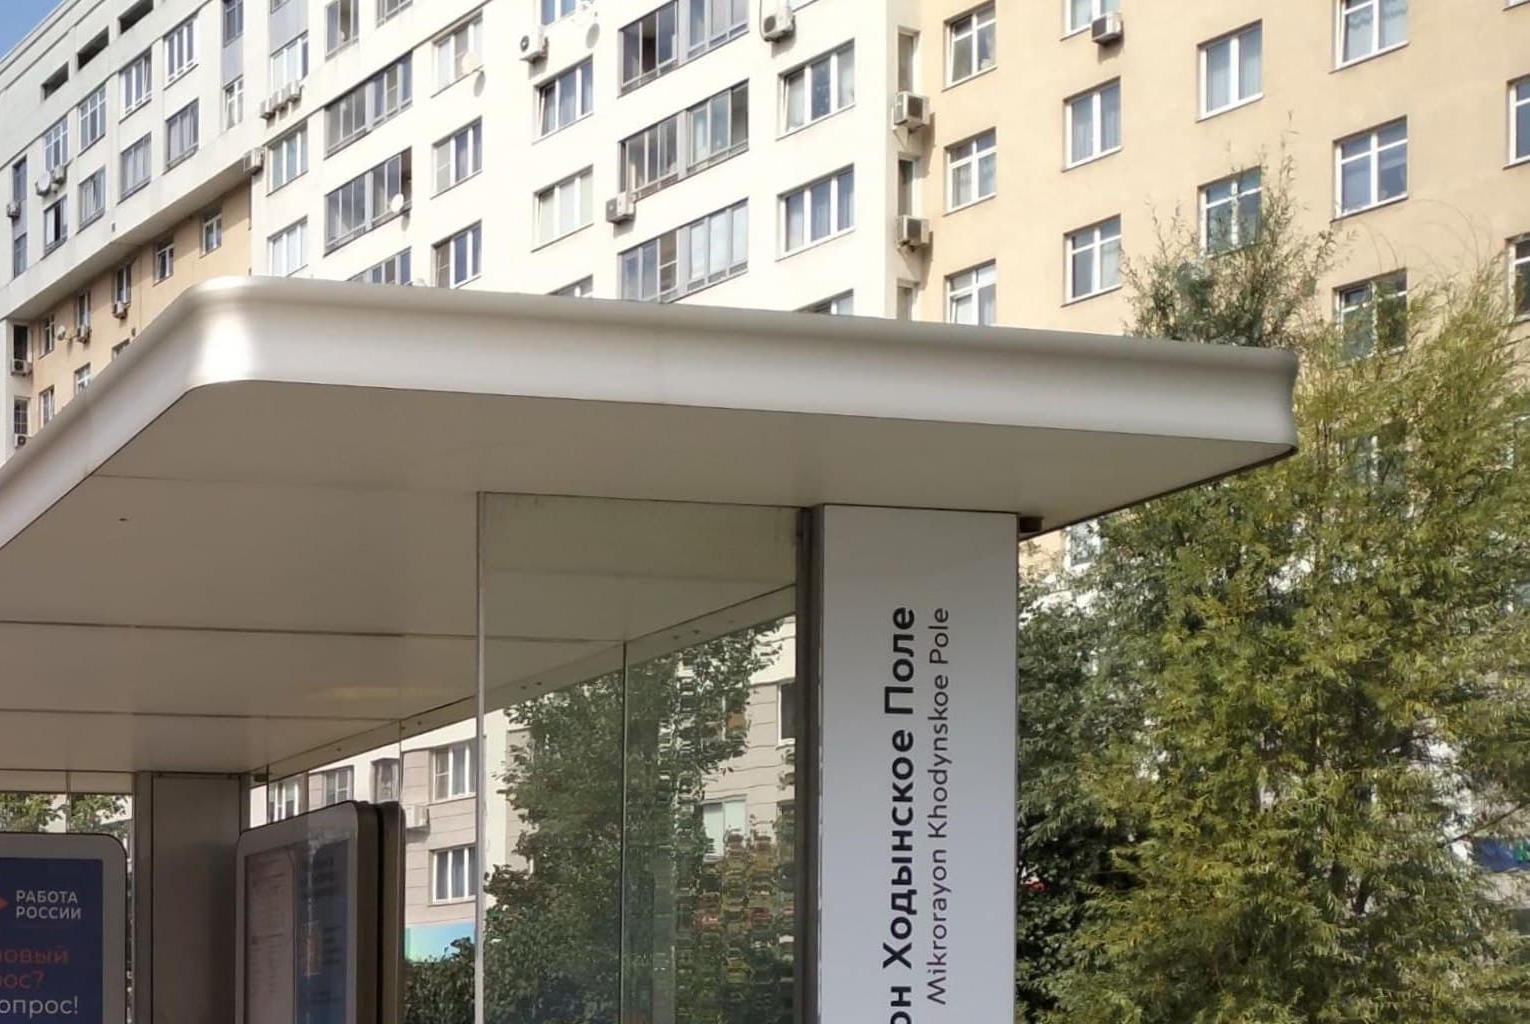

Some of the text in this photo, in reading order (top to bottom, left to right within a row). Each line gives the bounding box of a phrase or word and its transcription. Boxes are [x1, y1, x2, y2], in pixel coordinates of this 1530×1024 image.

[882, 607, 915, 714] Поле
[881, 729, 918, 969] Ходынское
[926, 607, 953, 1005] Mikrorayon Khodynskoe Pole
[16, 889, 79, 905] РАБОТА
[16, 906, 82, 921] РОССИИ
